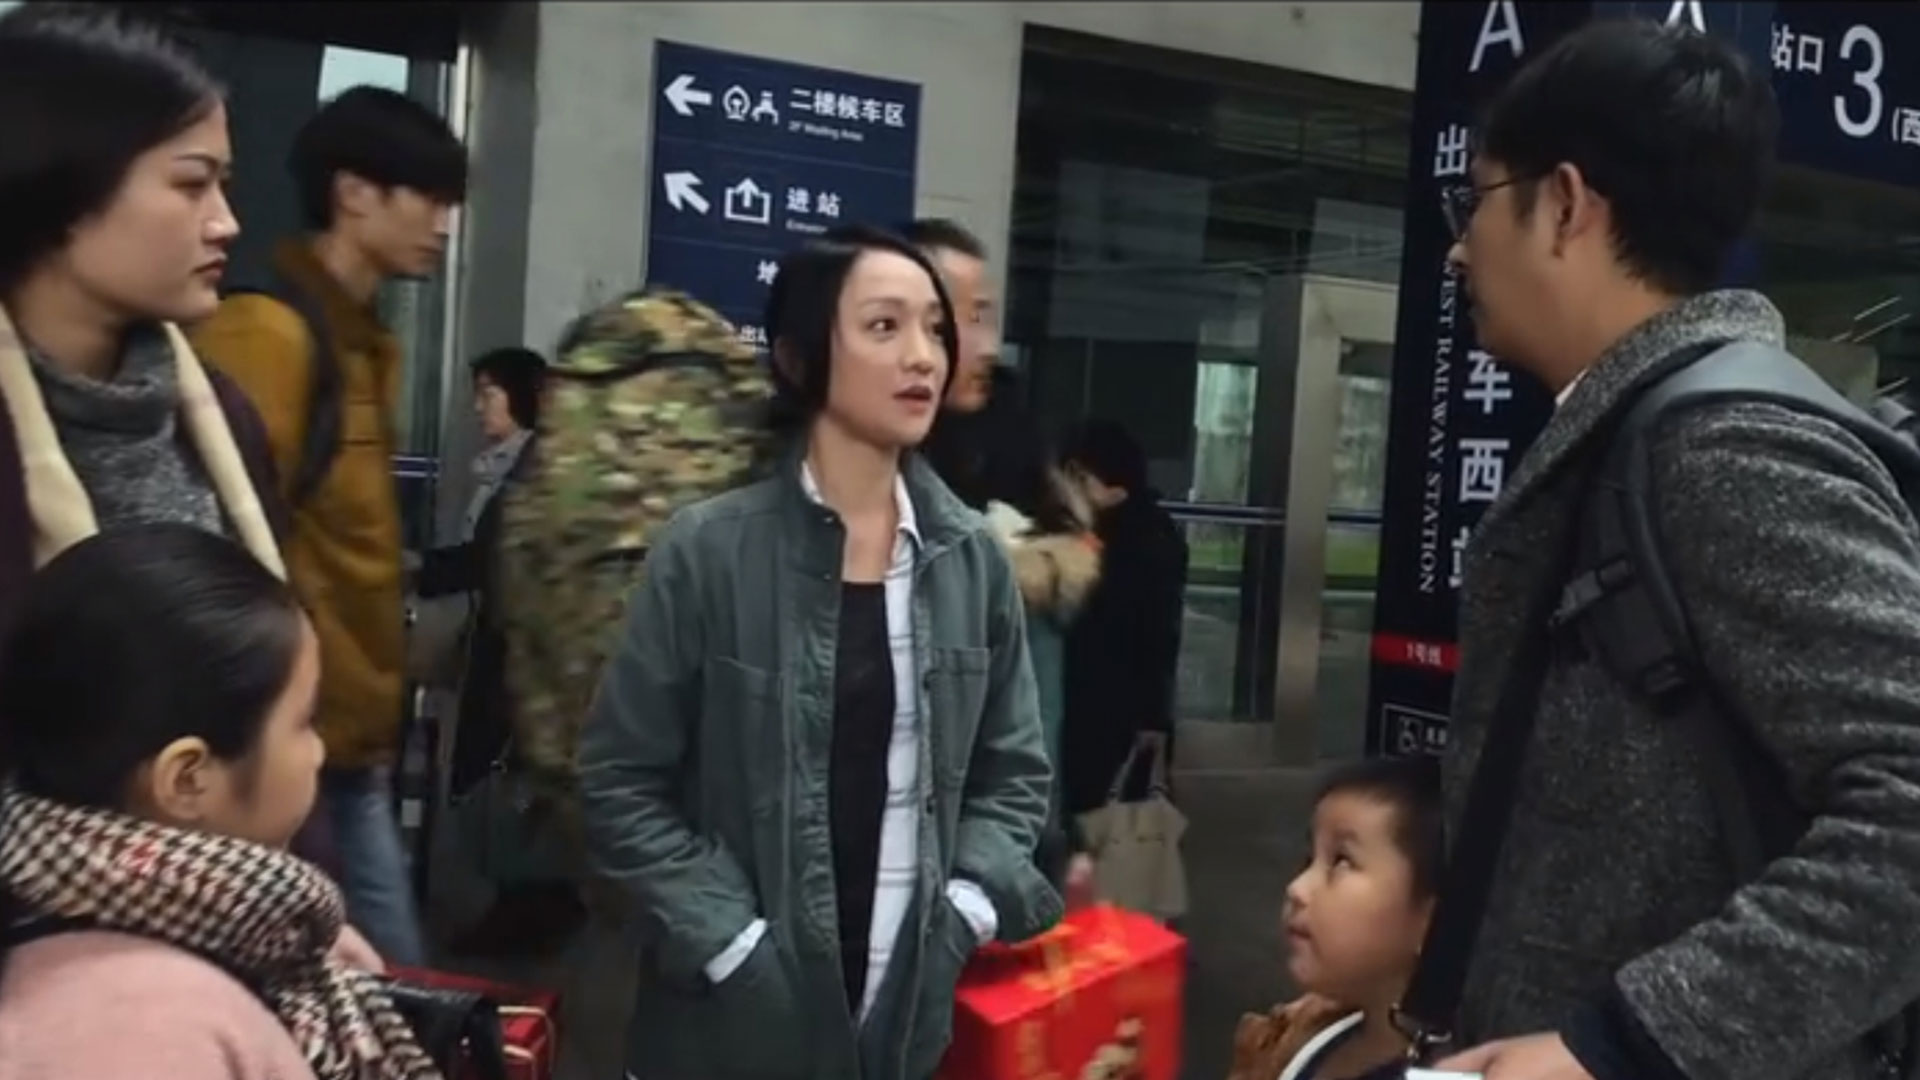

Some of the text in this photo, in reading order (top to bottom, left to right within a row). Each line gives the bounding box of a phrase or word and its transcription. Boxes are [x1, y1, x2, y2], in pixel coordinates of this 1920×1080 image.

[1468, 0, 1524, 72] A
[1834, 24, 1883, 137] 3
[789, 86, 906, 128] 二楼候车区
[1434, 124, 1467, 177] 出
[1428, 338, 1453, 464] RAILWAY
[1419, 471, 1442, 594] STATION
